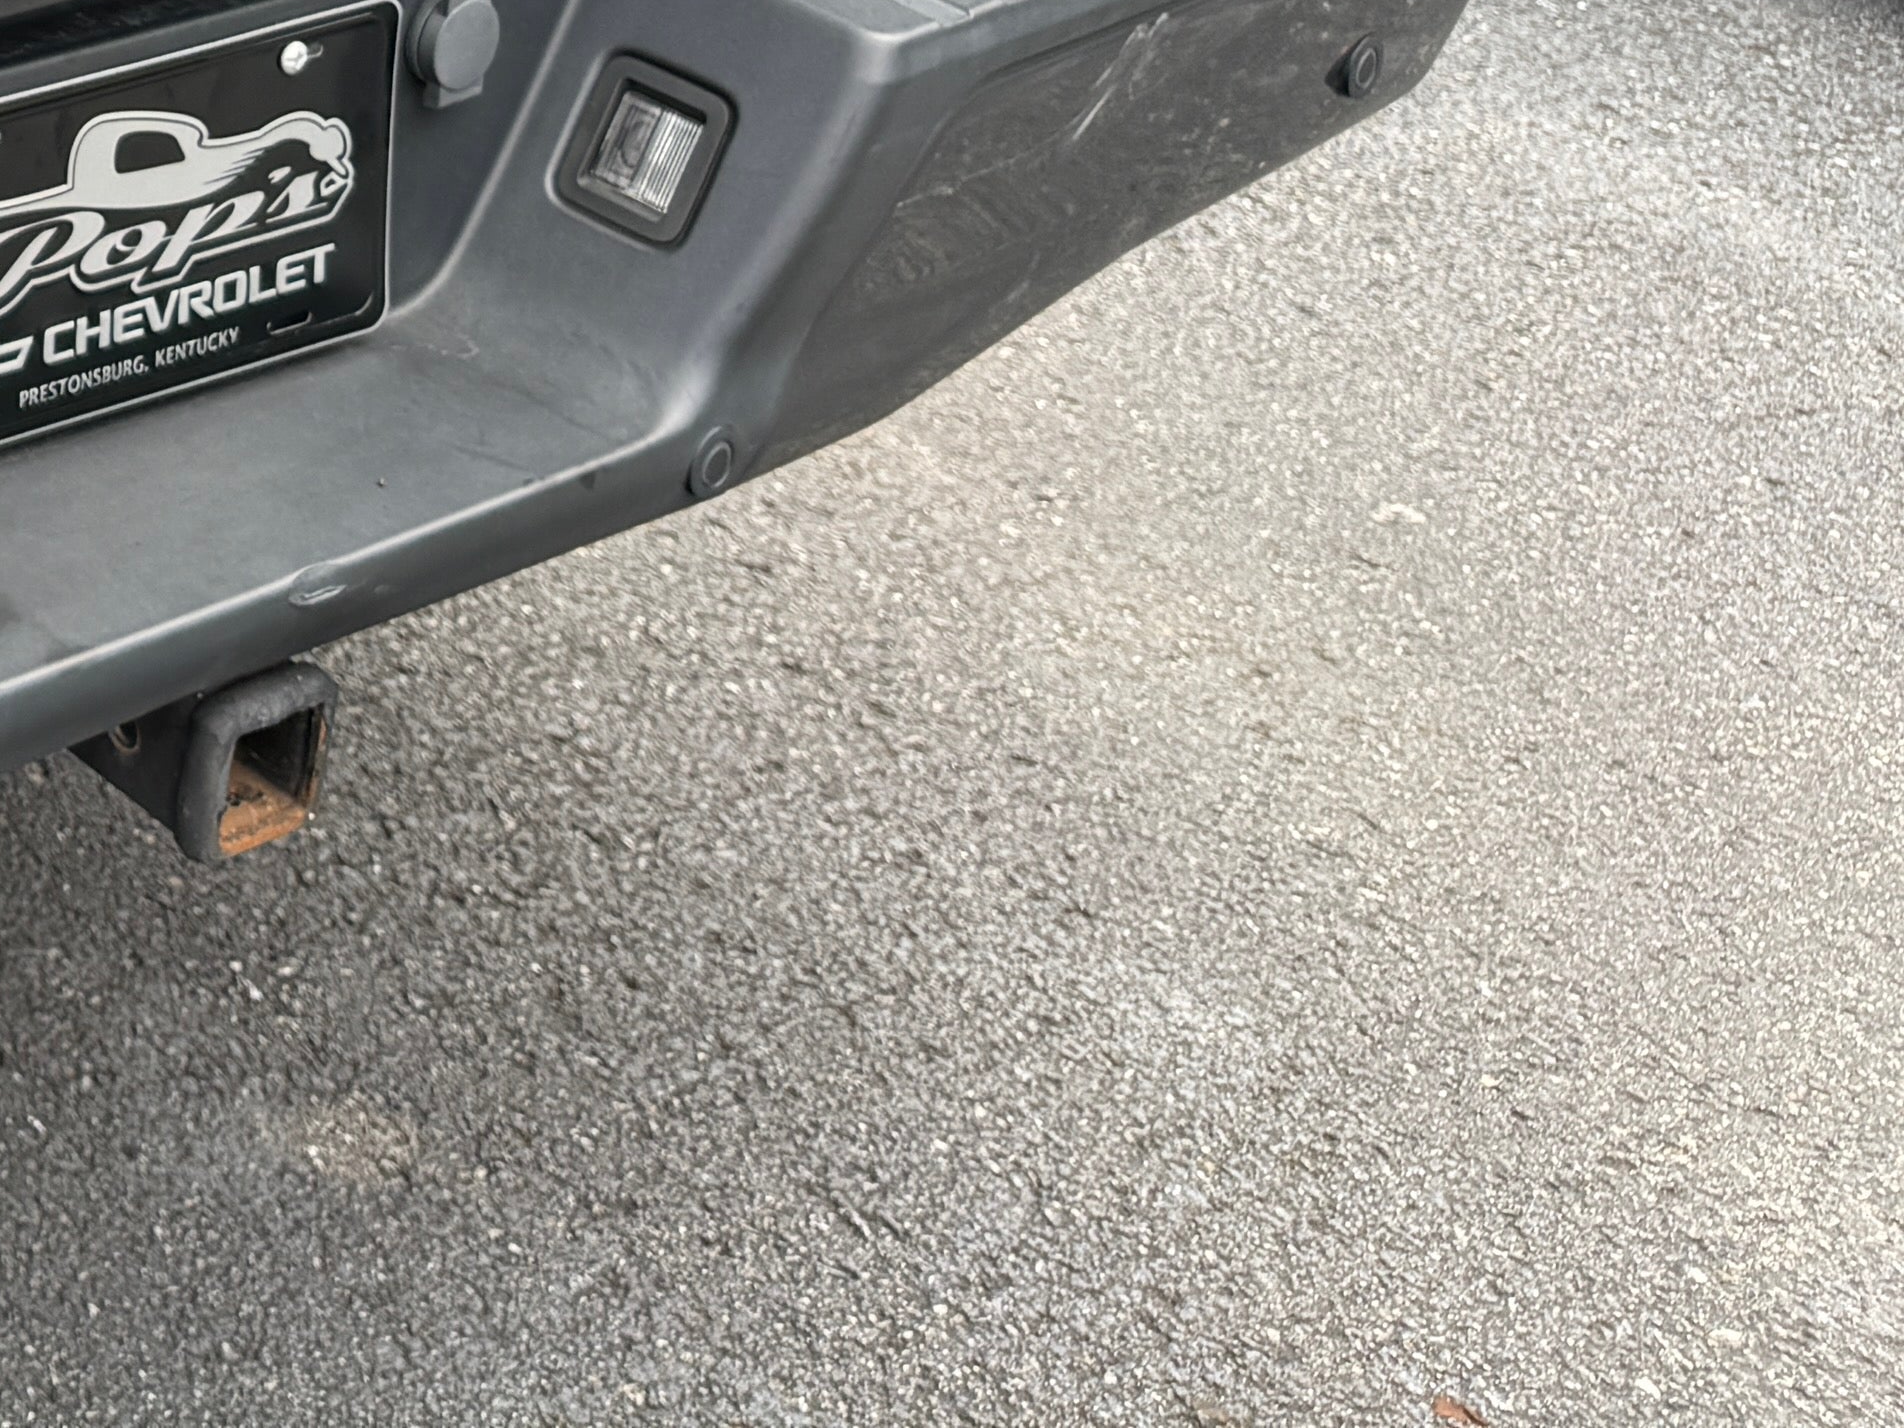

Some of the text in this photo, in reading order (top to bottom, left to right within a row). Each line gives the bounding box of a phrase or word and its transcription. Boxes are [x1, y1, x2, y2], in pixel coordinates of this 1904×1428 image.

[43, 242, 336, 366] CHEVROLET
[18, 325, 240, 410] PRESTONSBURG, KENTUCKY
